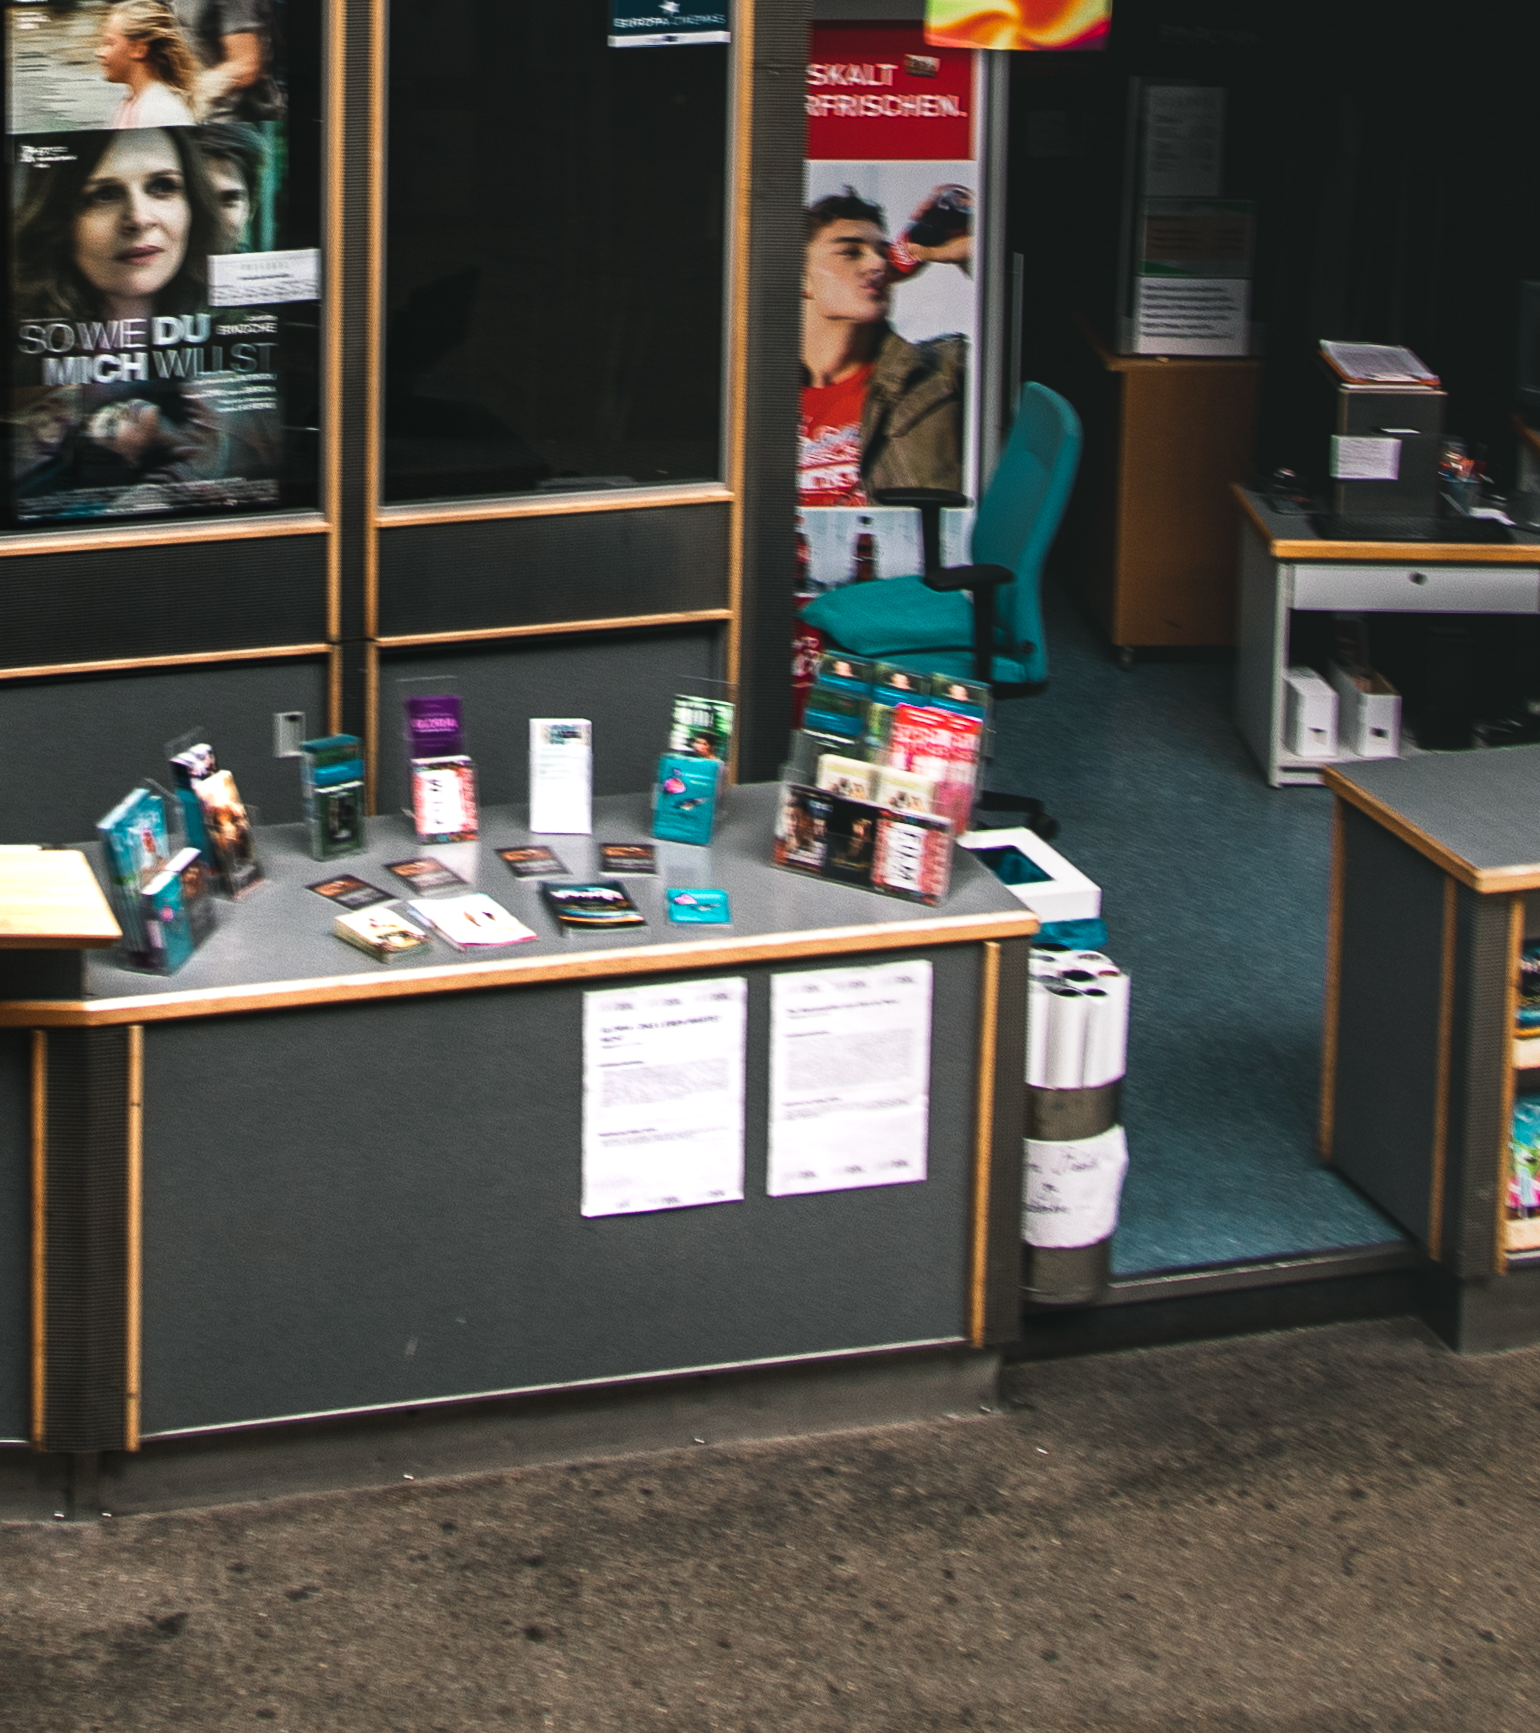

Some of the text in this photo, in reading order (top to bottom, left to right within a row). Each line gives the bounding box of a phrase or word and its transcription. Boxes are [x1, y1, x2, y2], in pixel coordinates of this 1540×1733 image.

[19, 322, 75, 355] SO
[151, 313, 212, 346] DU
[41, 341, 279, 387] MICH WILLST
